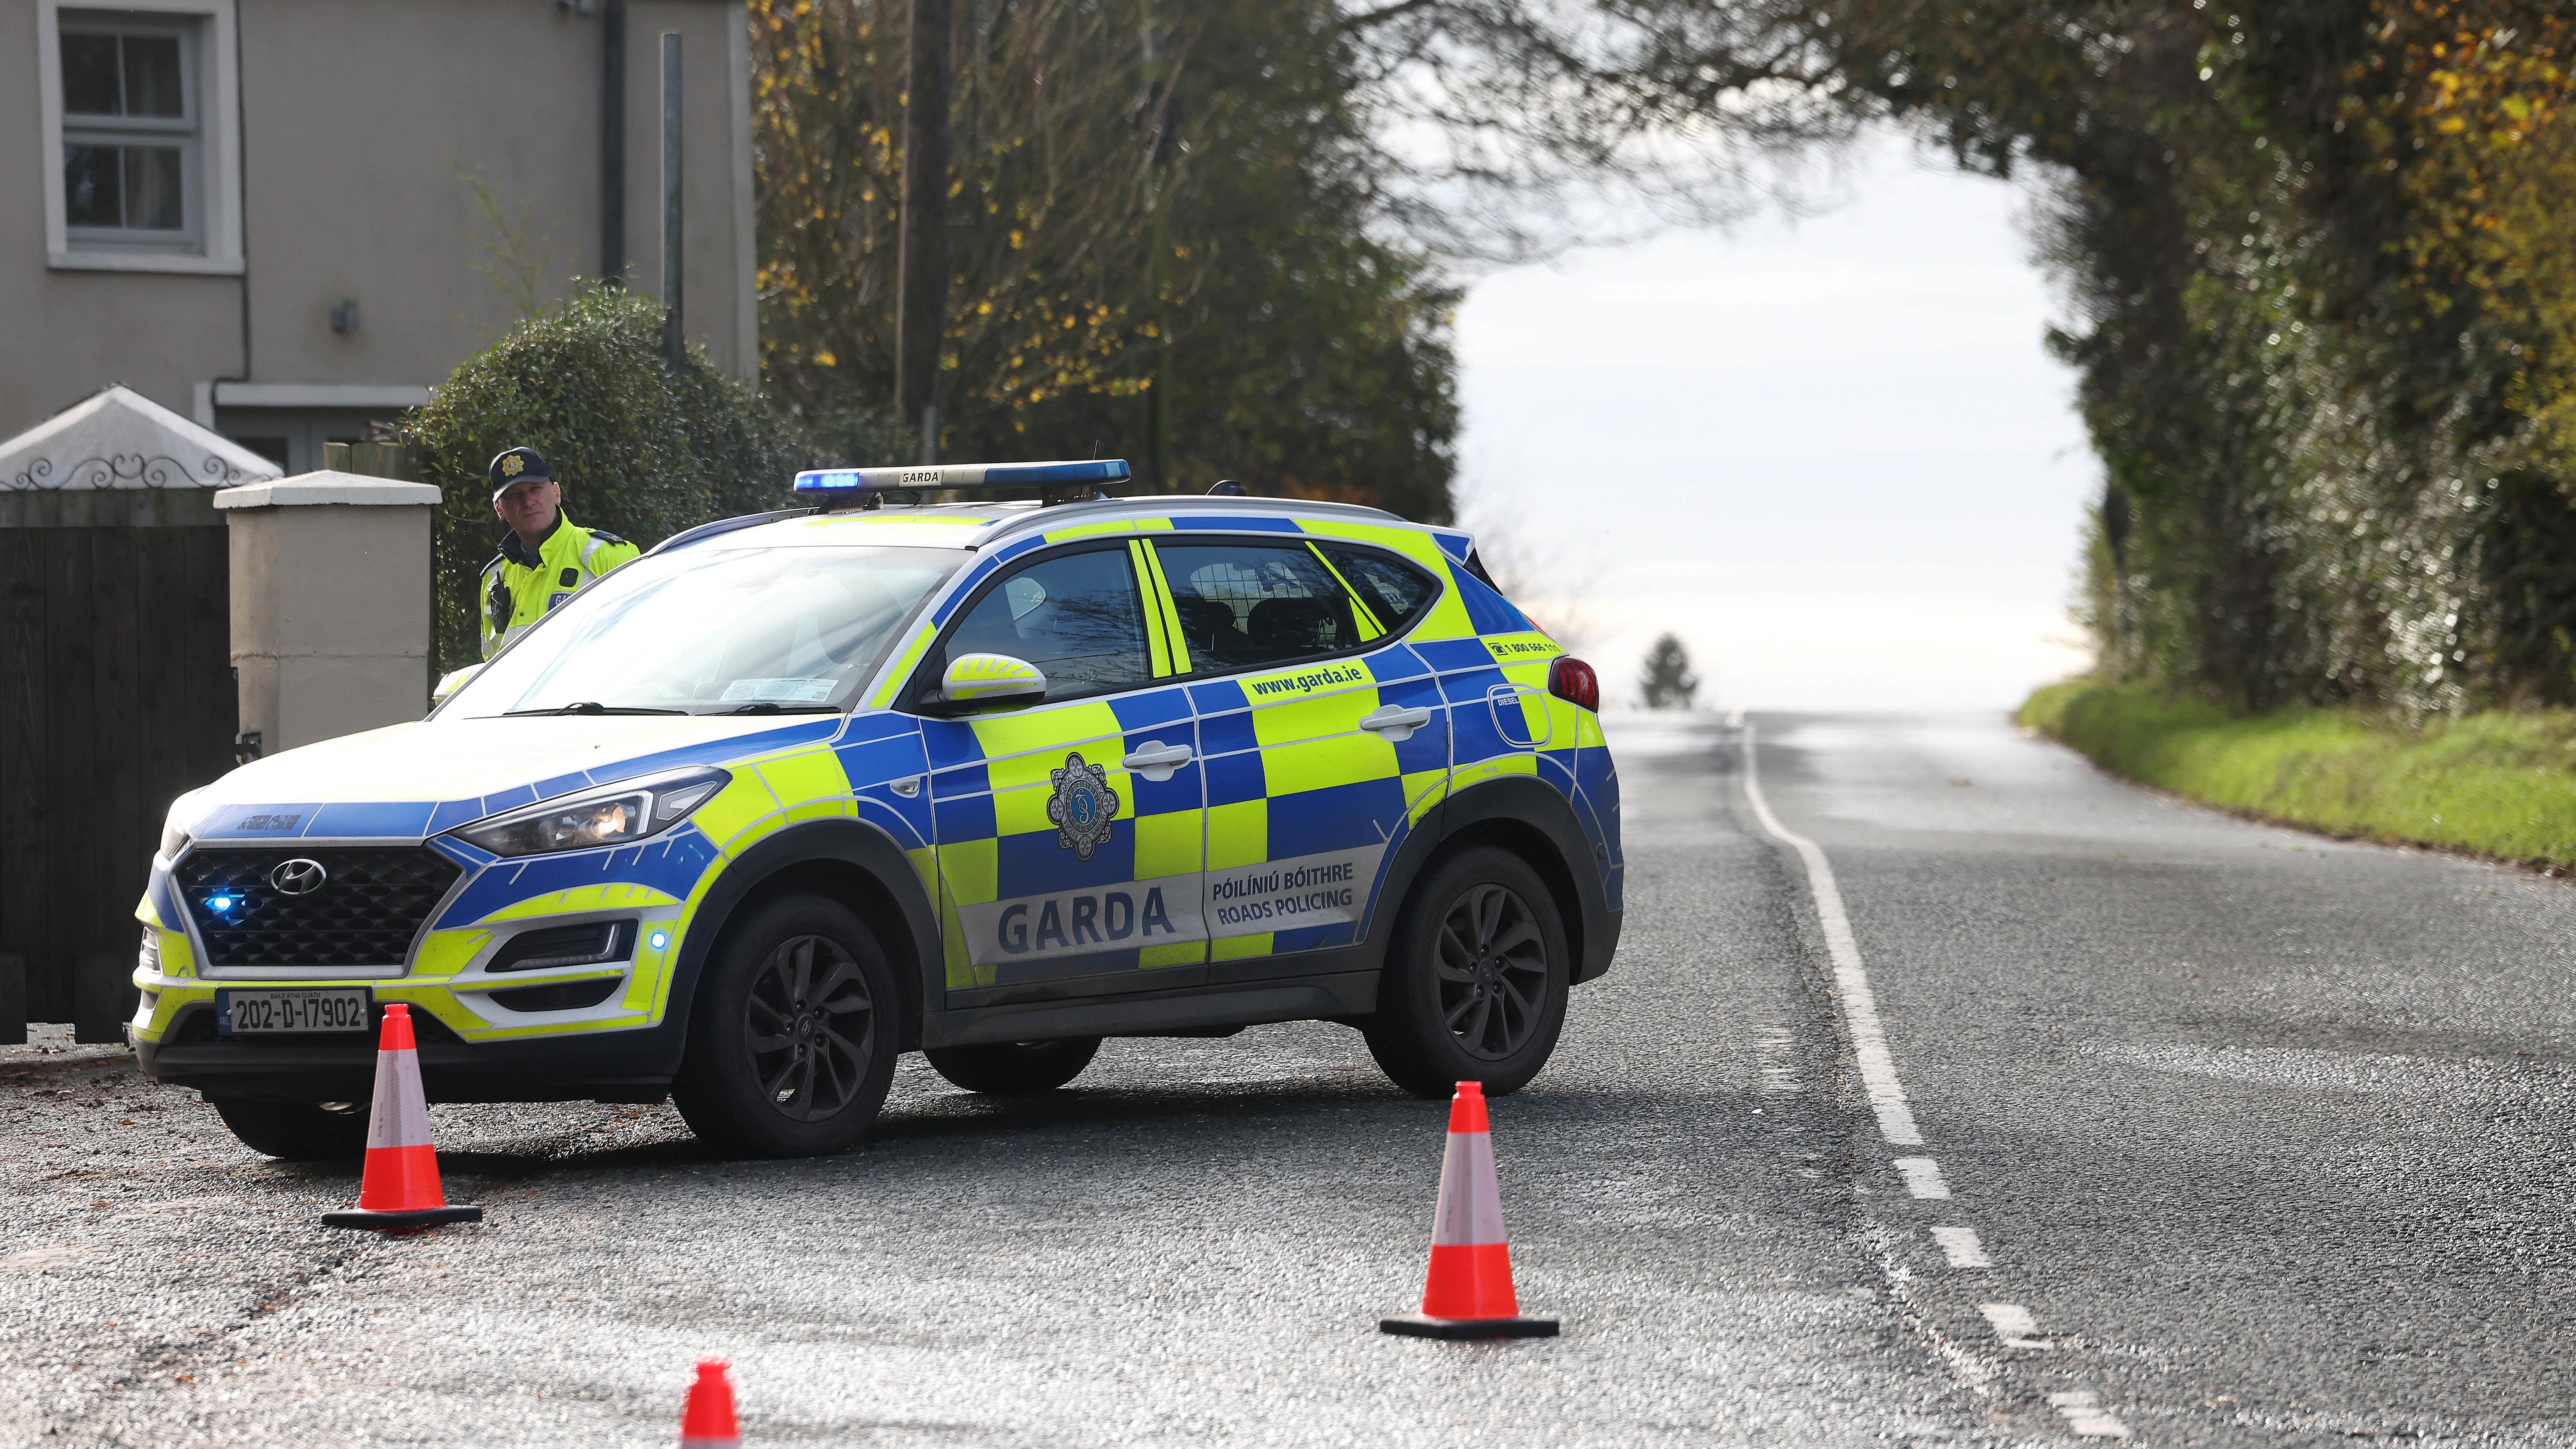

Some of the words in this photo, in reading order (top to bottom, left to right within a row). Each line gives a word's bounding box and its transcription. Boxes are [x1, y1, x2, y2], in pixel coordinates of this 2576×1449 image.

[903, 472, 939, 483] GARDA
[1511, 644, 1529, 652] 800
[1252, 665, 1362, 695] www.garda.ie
[1498, 697, 1519, 706] DIESEL
[1213, 870, 1279, 901] PÓILÍNIÚ
[1285, 863, 1353, 890] BÓITHRE
[998, 887, 1176, 954] GARDA
[1217, 901, 1273, 925] ROADS
[1275, 888, 1352, 916] POLICING
[219, 1016, 230, 1025] IRL
[237, 997, 361, 1029] 202-D-17902
